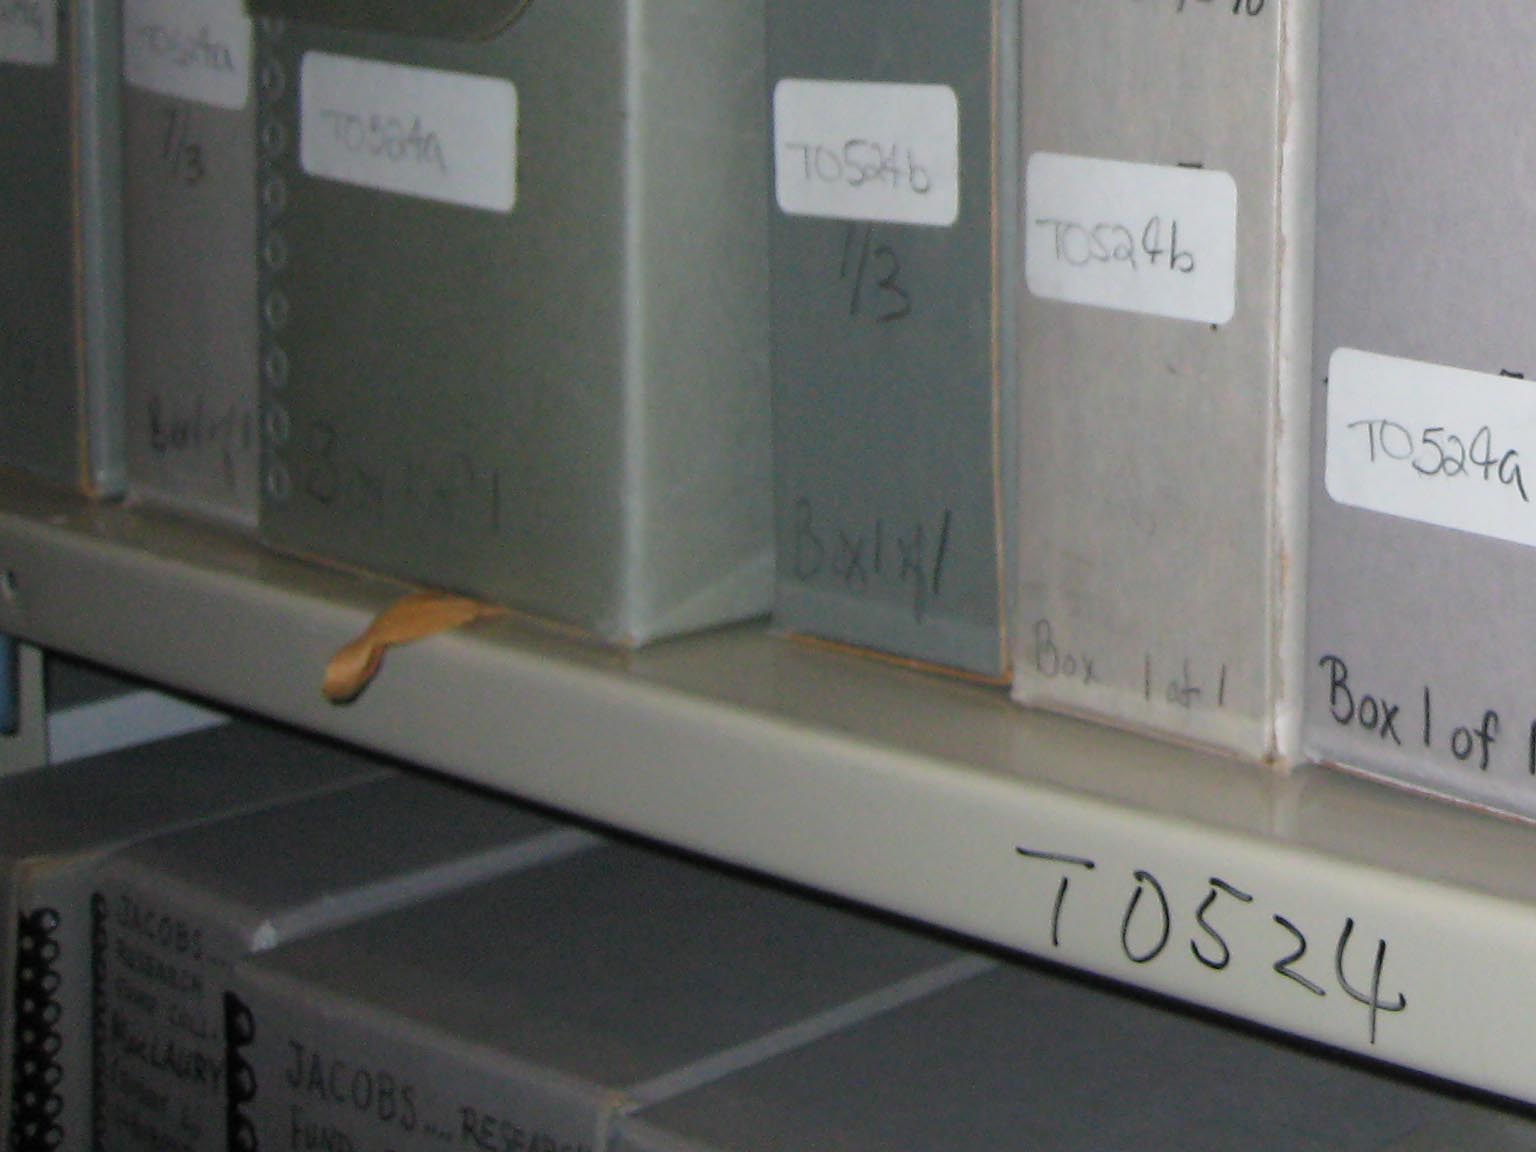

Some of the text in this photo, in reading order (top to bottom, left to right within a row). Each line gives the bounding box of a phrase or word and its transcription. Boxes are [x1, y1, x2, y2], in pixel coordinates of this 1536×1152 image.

[1319, 654, 1403, 746] Box
[1423, 685, 1432, 746] 1
[1450, 709, 1500, 771] of
